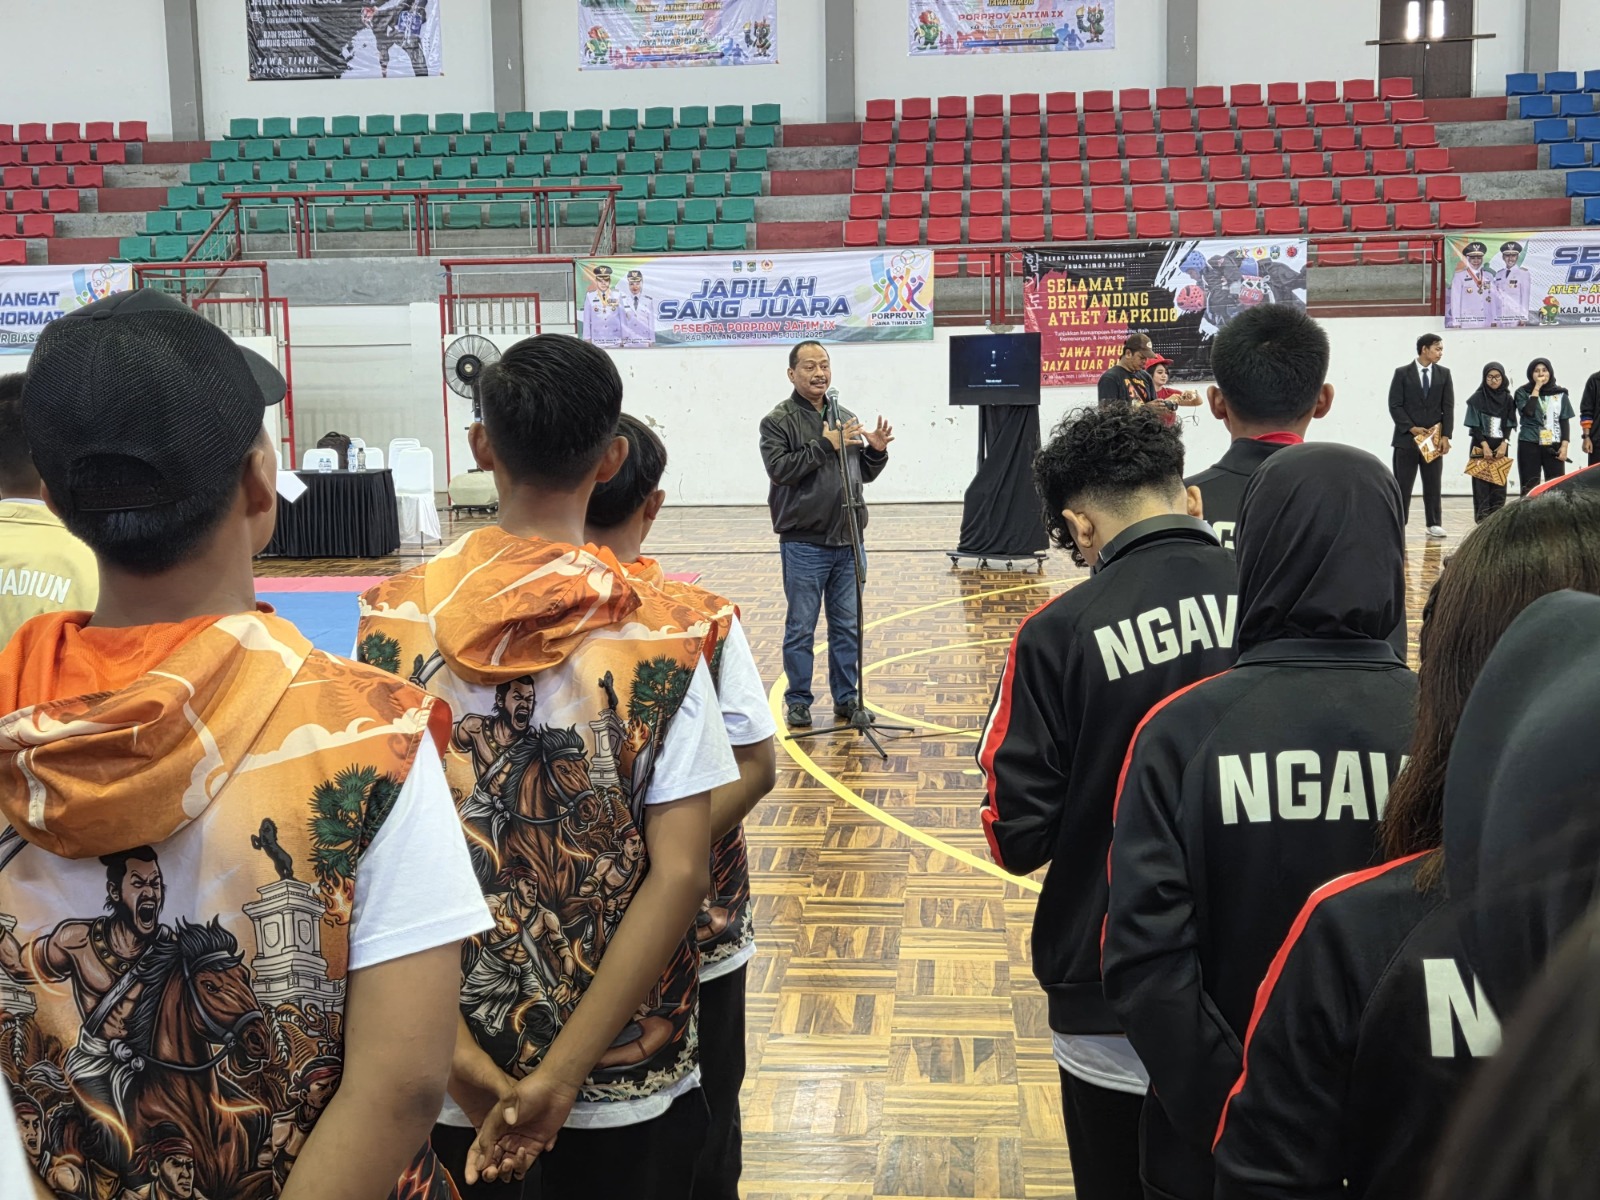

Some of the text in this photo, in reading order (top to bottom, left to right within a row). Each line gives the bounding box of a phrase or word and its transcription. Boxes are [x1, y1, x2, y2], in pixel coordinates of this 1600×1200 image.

[958, 10, 1064, 21] PORPROV JATIM IX
[257, 56, 319, 66] JAWA TIMUR
[1552, 246, 1600, 265] SE
[690, 276, 818, 300] JADILAH
[1047, 276, 1125, 293] SELAMAT
[1548, 284, 1580, 295] ATLET
[0, 292, 59, 307] ANGAT
[1047, 292, 1149, 310] BERTANDING
[658, 297, 851, 321] SANG JUARA
[871, 311, 926, 320] PORPROV IX
[1048, 310, 1101, 326] ATLET
[1107, 308, 1178, 324] HAPKIDO
[673, 320, 837, 334] PESERTA PORPROV JATIM IX
[741, 332, 750, 340] 28
[804, 331, 824, 339] 2025
[1059, 345, 1126, 358] JAWA TIMU
[1042, 360, 1070, 372] JAYA
[1075, 359, 1103, 371] LUAR
[1423, 958, 1502, 1057] N
